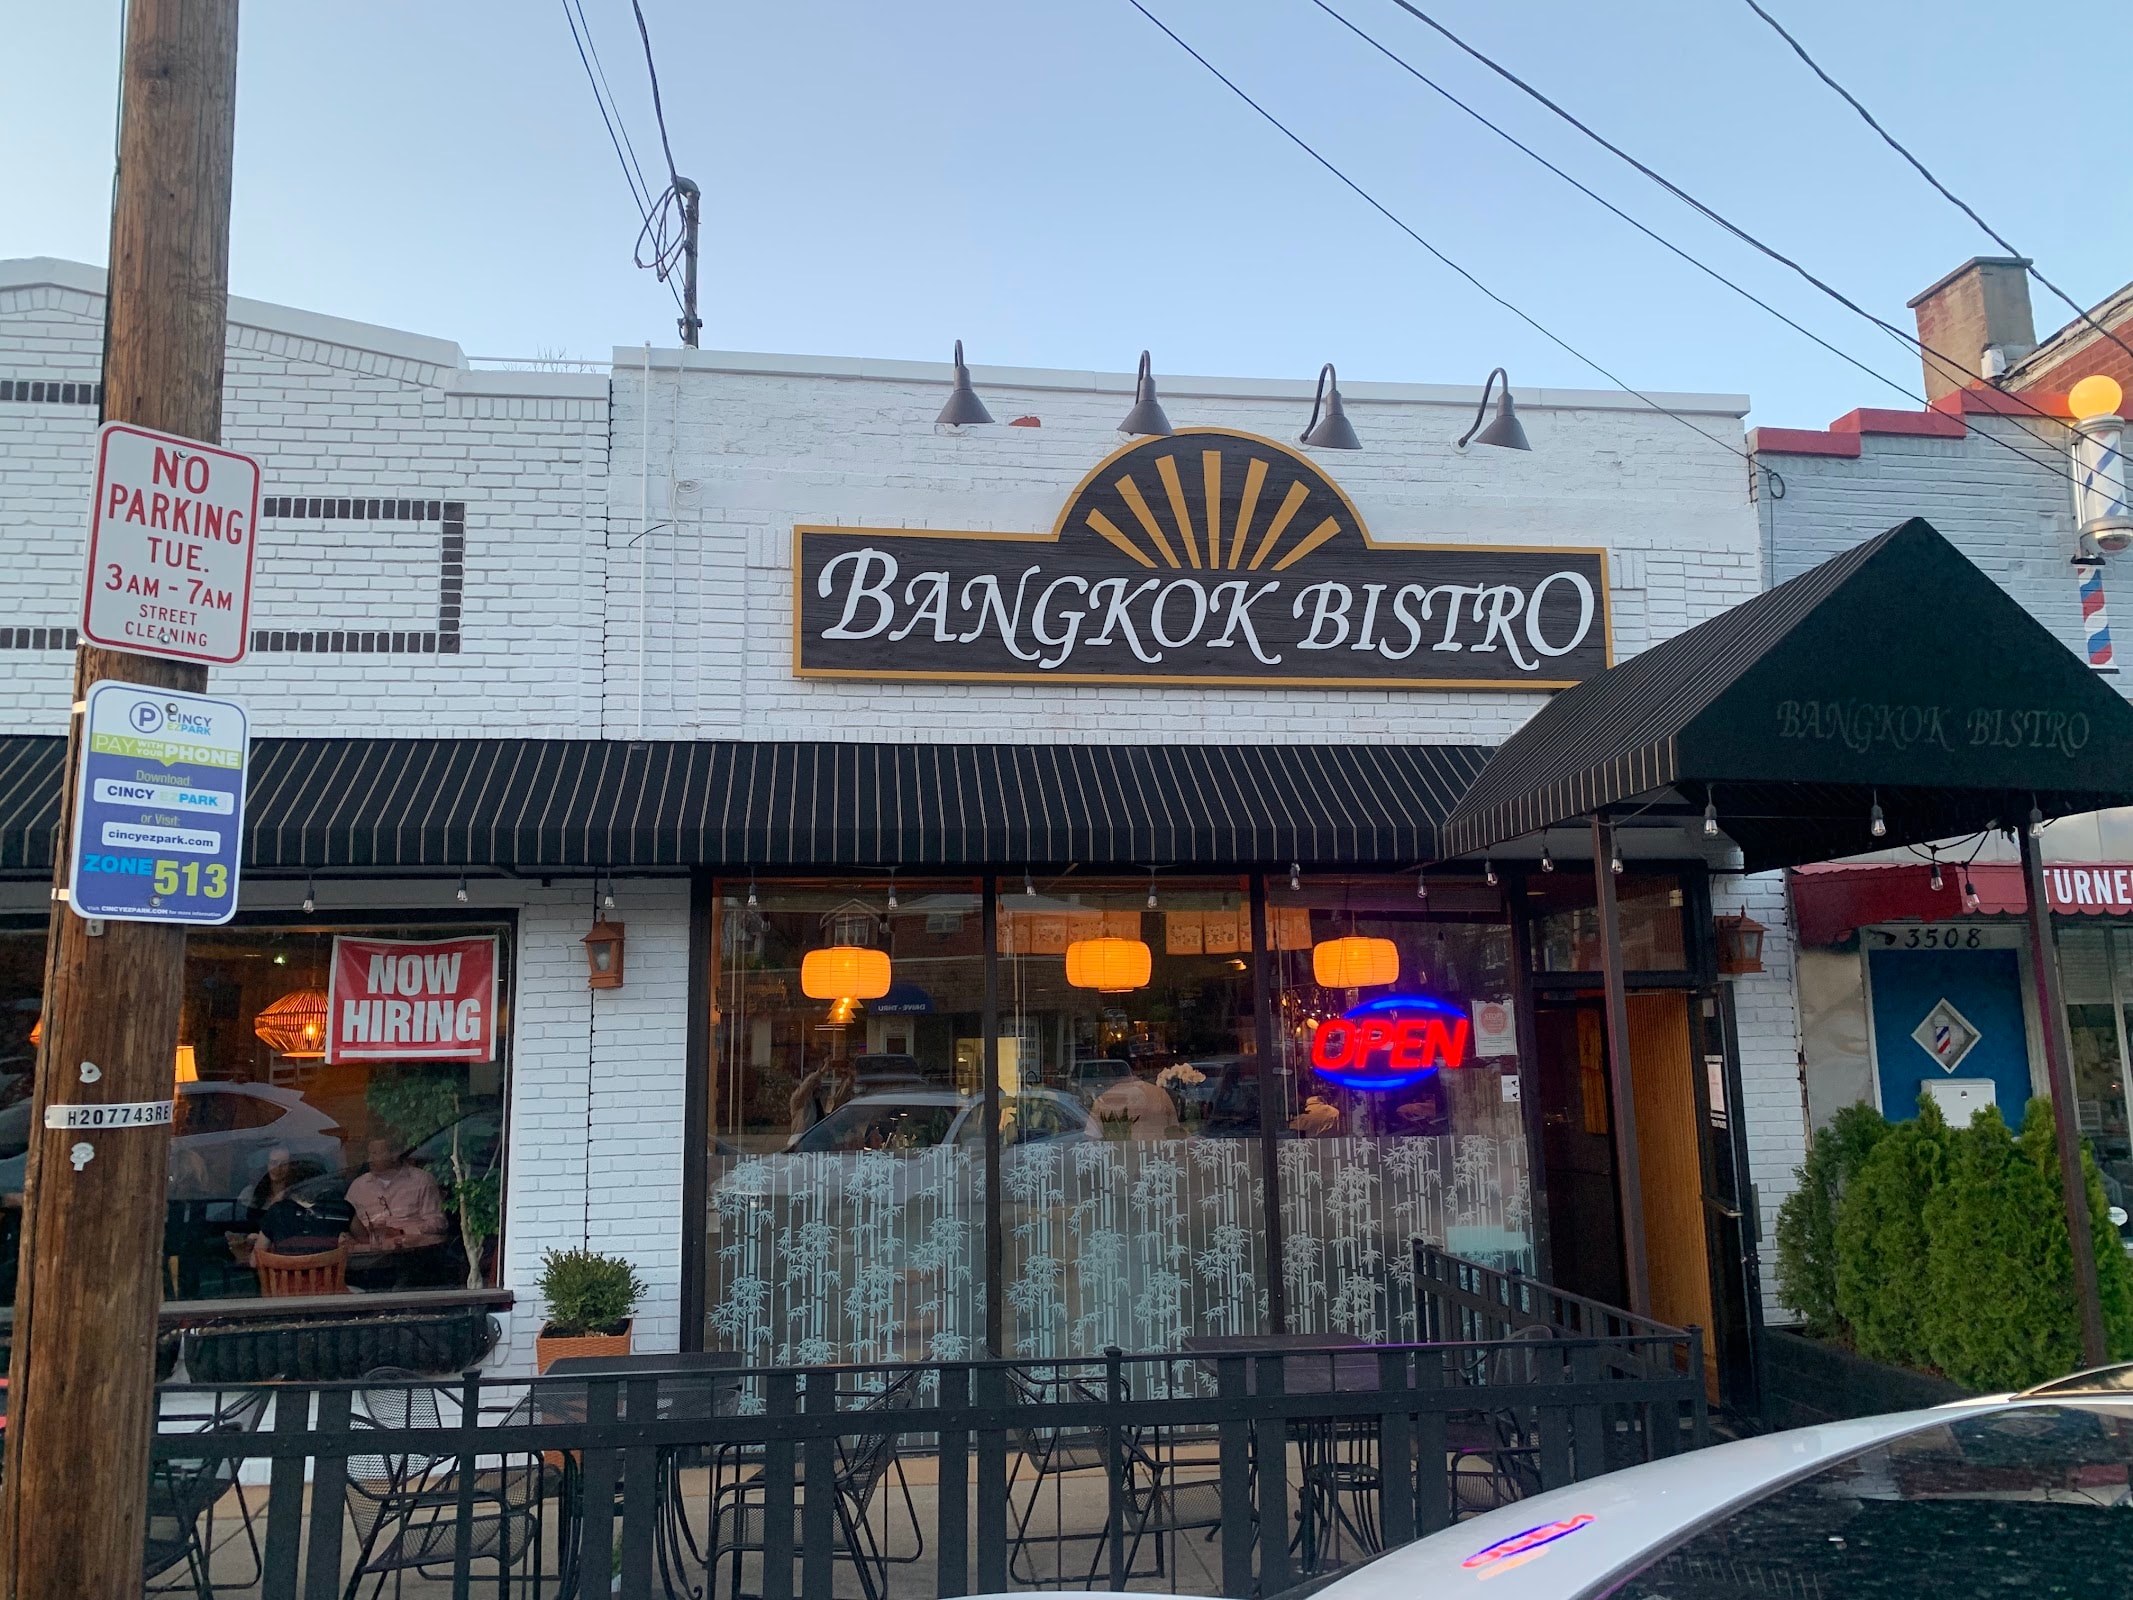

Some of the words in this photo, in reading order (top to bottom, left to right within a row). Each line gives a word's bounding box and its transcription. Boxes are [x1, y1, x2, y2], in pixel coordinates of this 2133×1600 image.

[153, 447, 209, 494] NO
[108, 483, 243, 545] PARKING
[147, 536, 209, 573] TUE.
[139, 604, 197, 626] STREET
[818, 547, 1281, 669] BANGKOK
[1293, 571, 1595, 671] BISTRO
[125, 621, 208, 647] CLEANING
[167, 712, 212, 728] CINCY
[167, 722, 211, 736] EZPARK
[1777, 699, 1954, 754] BANGKOK
[1968, 708, 2090, 758] BISTRO
[96, 735, 136, 753] PAY
[136, 747, 163, 757] YOUR
[137, 739, 164, 750] WITH
[164, 744, 239, 767] PHONE
[136, 769, 193, 786] Download:
[107, 785, 154, 800] CINCY
[141, 815, 151, 824] or
[155, 814, 181, 826] Visit:
[108, 829, 213, 847] cincyezpark.com
[83, 853, 153, 876] ZONE
[154, 859, 228, 899] 513
[101, 905, 168, 915] CINCYEZPARK.COM
[1904, 927, 1982, 949] 3508
[367, 952, 462, 996] NOW
[342, 998, 481, 1043] HIRING
[1311, 1018, 1468, 1069] OPEN
[68, 1105, 170, 1126] H207743RE
